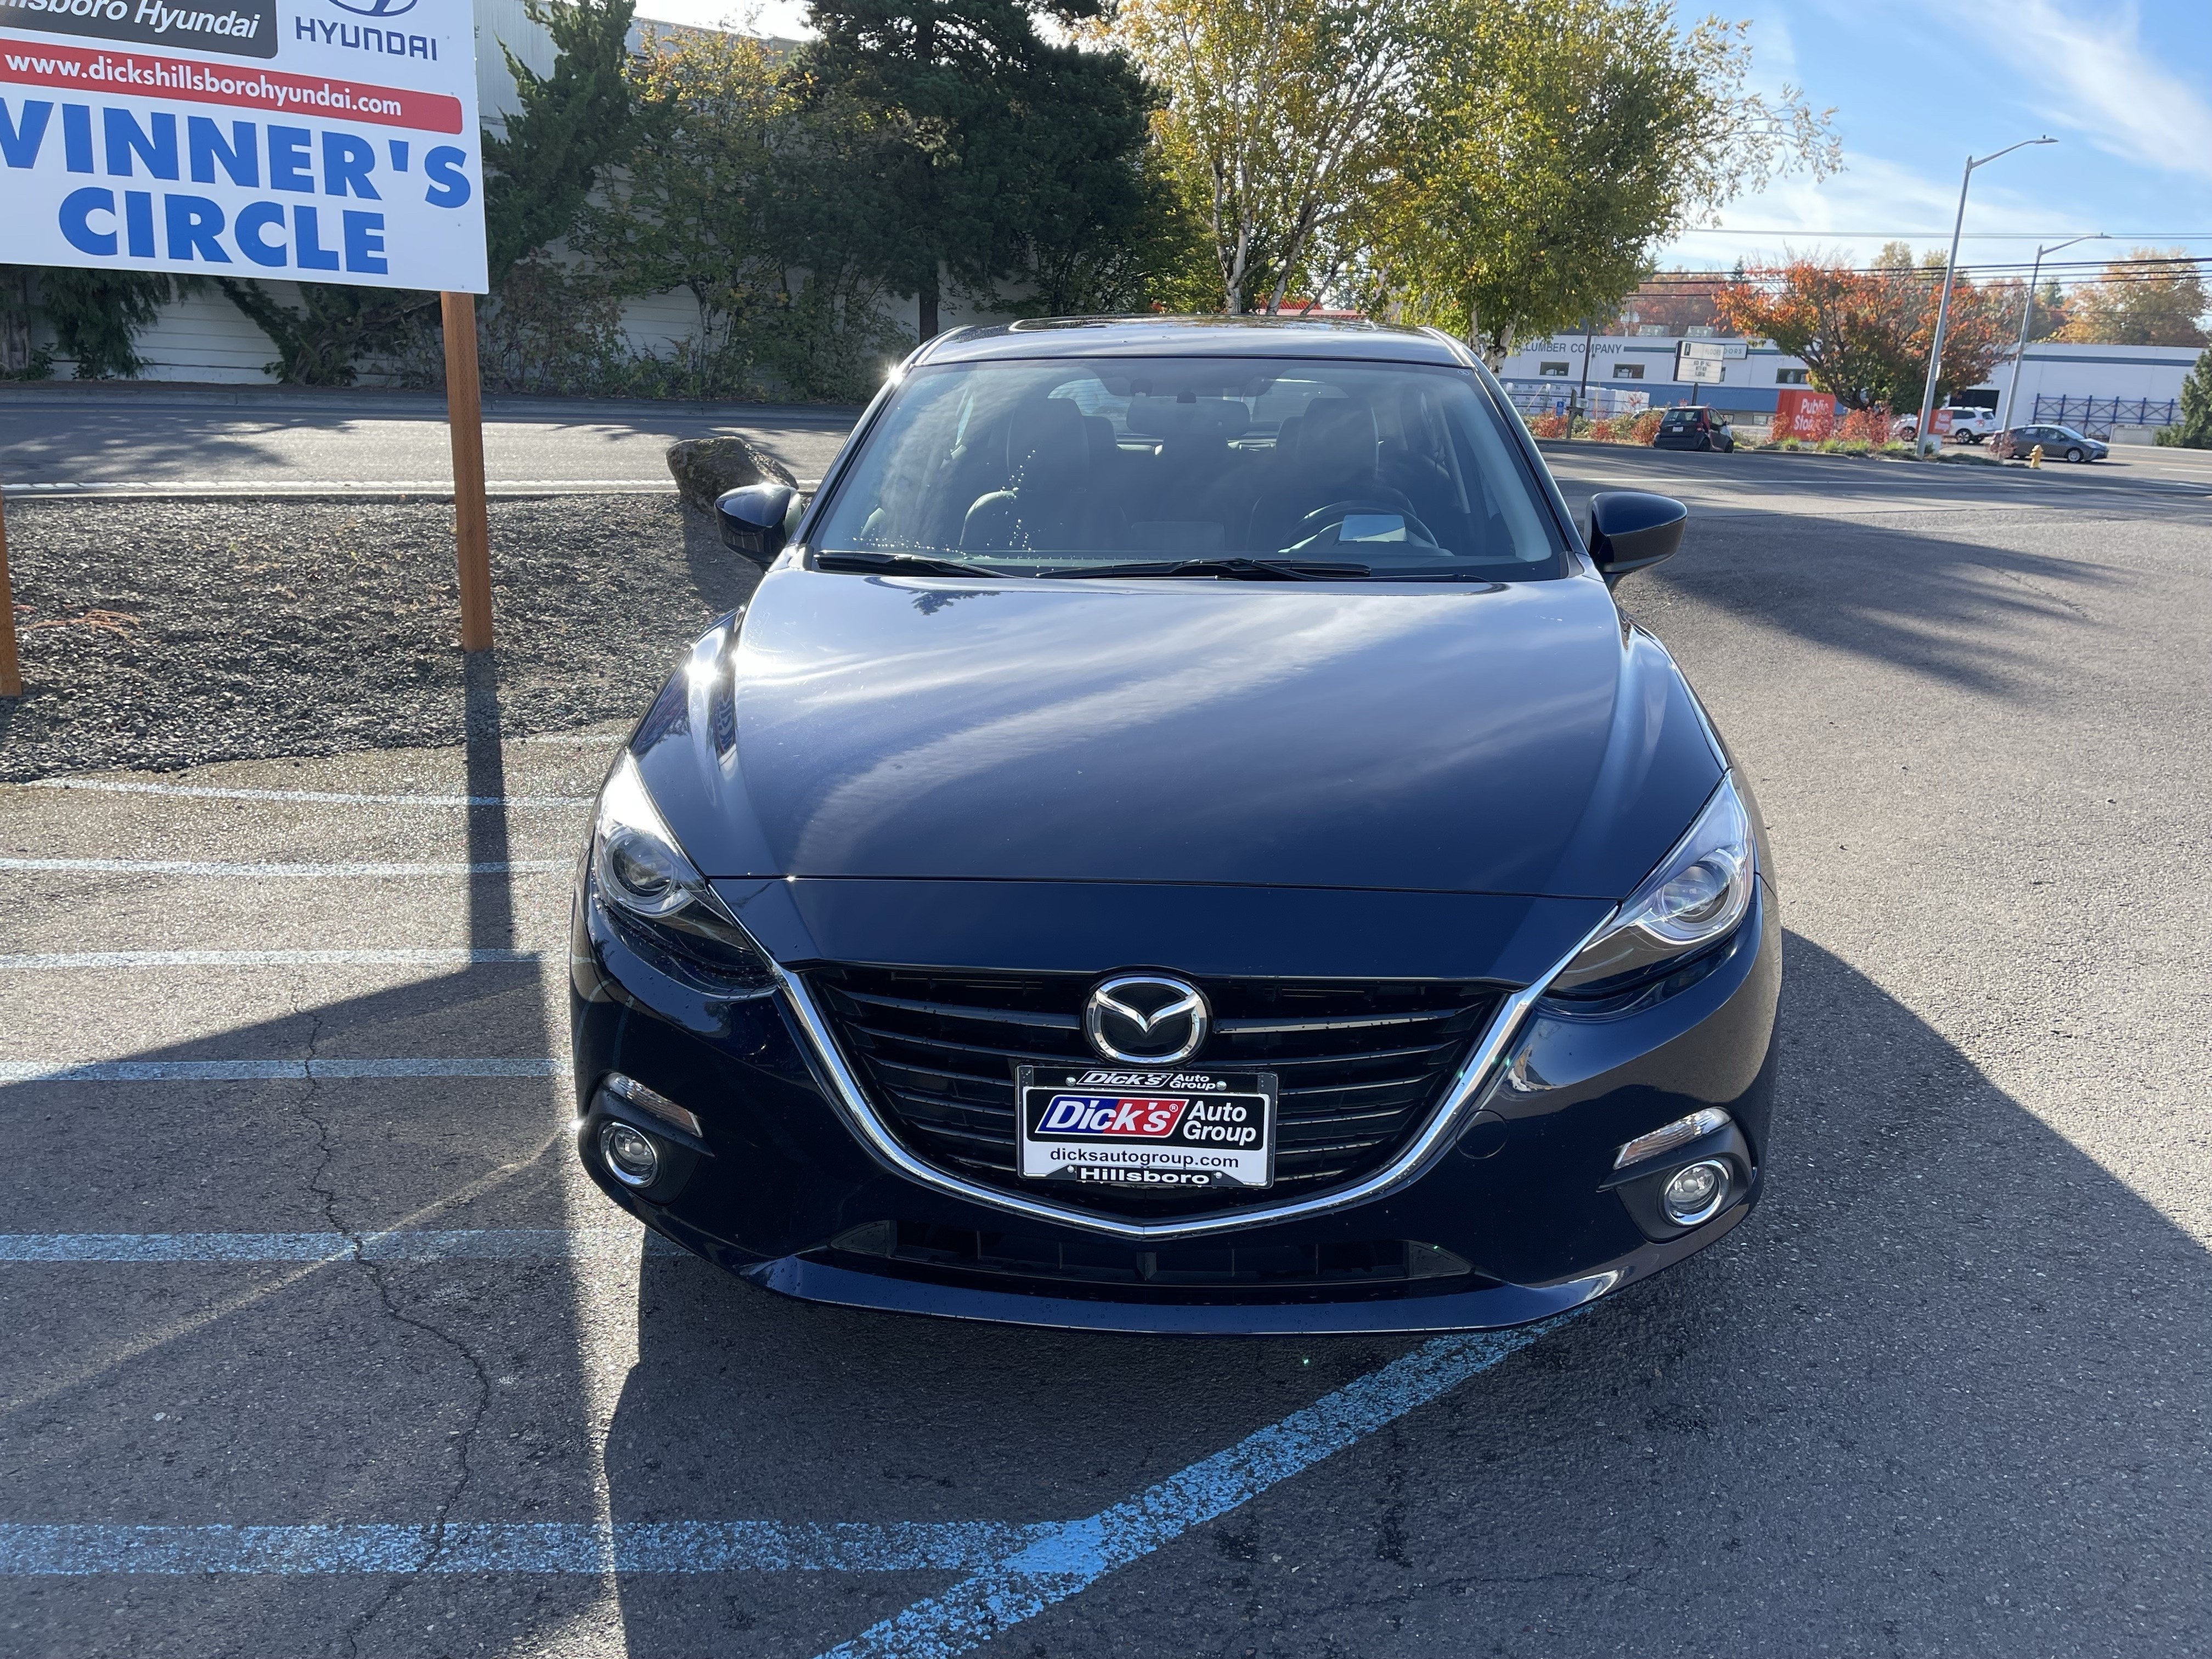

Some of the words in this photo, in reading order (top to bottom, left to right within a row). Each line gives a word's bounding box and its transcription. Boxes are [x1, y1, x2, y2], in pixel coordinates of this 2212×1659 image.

[0, 0, 128, 20] sboro
[134, 0, 261, 38] Hyundai
[295, 15, 437, 61] HYUNDAI
[4, 54, 402, 116] www.dickshillsborohyundai.com
[58, 187, 388, 275] CIRCLE
[1526, 343, 1566, 352] LUMBER
[1571, 343, 1622, 353] COMPANY
[1084, 1073, 1163, 1086] Dick's
[1169, 1081, 1216, 1091] Group
[1173, 1074, 1210, 1082] Auto
[1046, 1100, 1171, 1132] Dick's
[1187, 1101, 1247, 1122] Auto
[1183, 1120, 1256, 1146] Group
[1050, 1147, 1239, 1168] dicksautogroup.com
[1080, 1167, 1210, 1185] Hillsboro
